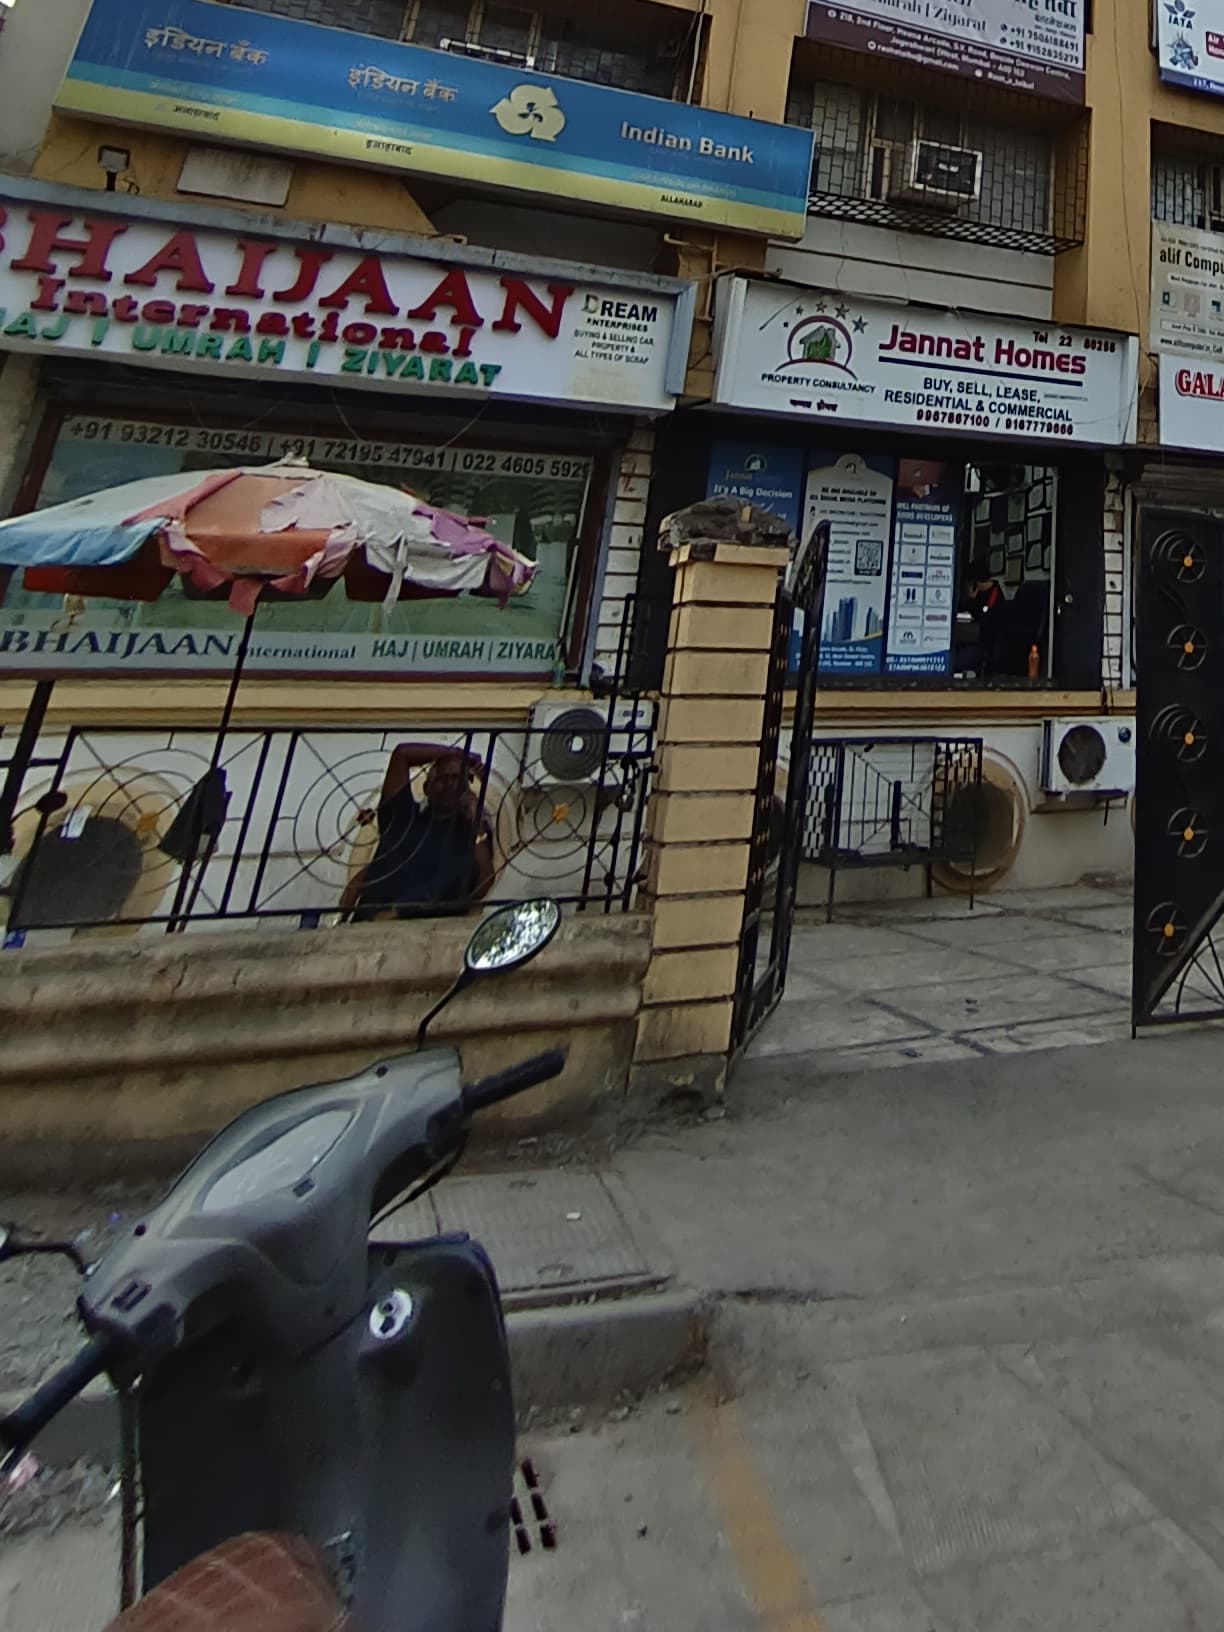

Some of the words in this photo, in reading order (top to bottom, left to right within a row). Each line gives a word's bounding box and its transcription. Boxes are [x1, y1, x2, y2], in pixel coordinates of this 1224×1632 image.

[932, 1, 988, 33] Ziyarat
[1167, 14, 1194, 30] IATA
[1207, 33, 1220, 45] Air
[619, 120, 692, 152] Indian
[699, 136, 756, 165] Bank
[659, 193, 704, 209] ALLAHABAD
[1159, 246, 1181, 265] alif
[0, 206, 575, 339] HAIJAAN
[30, 274, 477, 358] International
[581, 293, 659, 323] DREAM
[591, 341, 630, 353] PROPERTY
[609, 333, 639, 344] SELLING
[878, 323, 985, 364] Jannat
[994, 338, 1088, 376] Homes
[1058, 334, 1073, 348] 22
[131, 325, 287, 365] UMRAH
[340, 347, 503, 388] ZIYARAT
[574, 349, 589, 359] ALL
[590, 350, 613, 361] TYPES
[761, 372, 812, 388] PROPERTY
[812, 377, 877, 395] CONSULTANCY
[923, 376, 954, 394] BUY,
[956, 380, 993, 399] SELL,
[996, 385, 1042, 404] LEASE,
[883, 389, 973, 412] RESIDENTIAL
[975, 399, 986, 413] &
[988, 400, 1074, 423] COMMERCIAL
[71, 421, 113, 441] +91
[120, 421, 190, 448] 93212
[279, 437, 316, 459] +91
[323, 440, 382, 463] 72195
[386, 445, 447, 468] 47941
[461, 453, 496, 473] 022
[501, 455, 545, 476] 4605
[730, 485, 738, 495] A
[739, 486, 755, 498] Big
[755, 487, 794, 499] Decision
[0, 629, 237, 660] BHAIJAAN
[371, 638, 409, 660] HAJ
[422, 639, 484, 660] UMRAH
